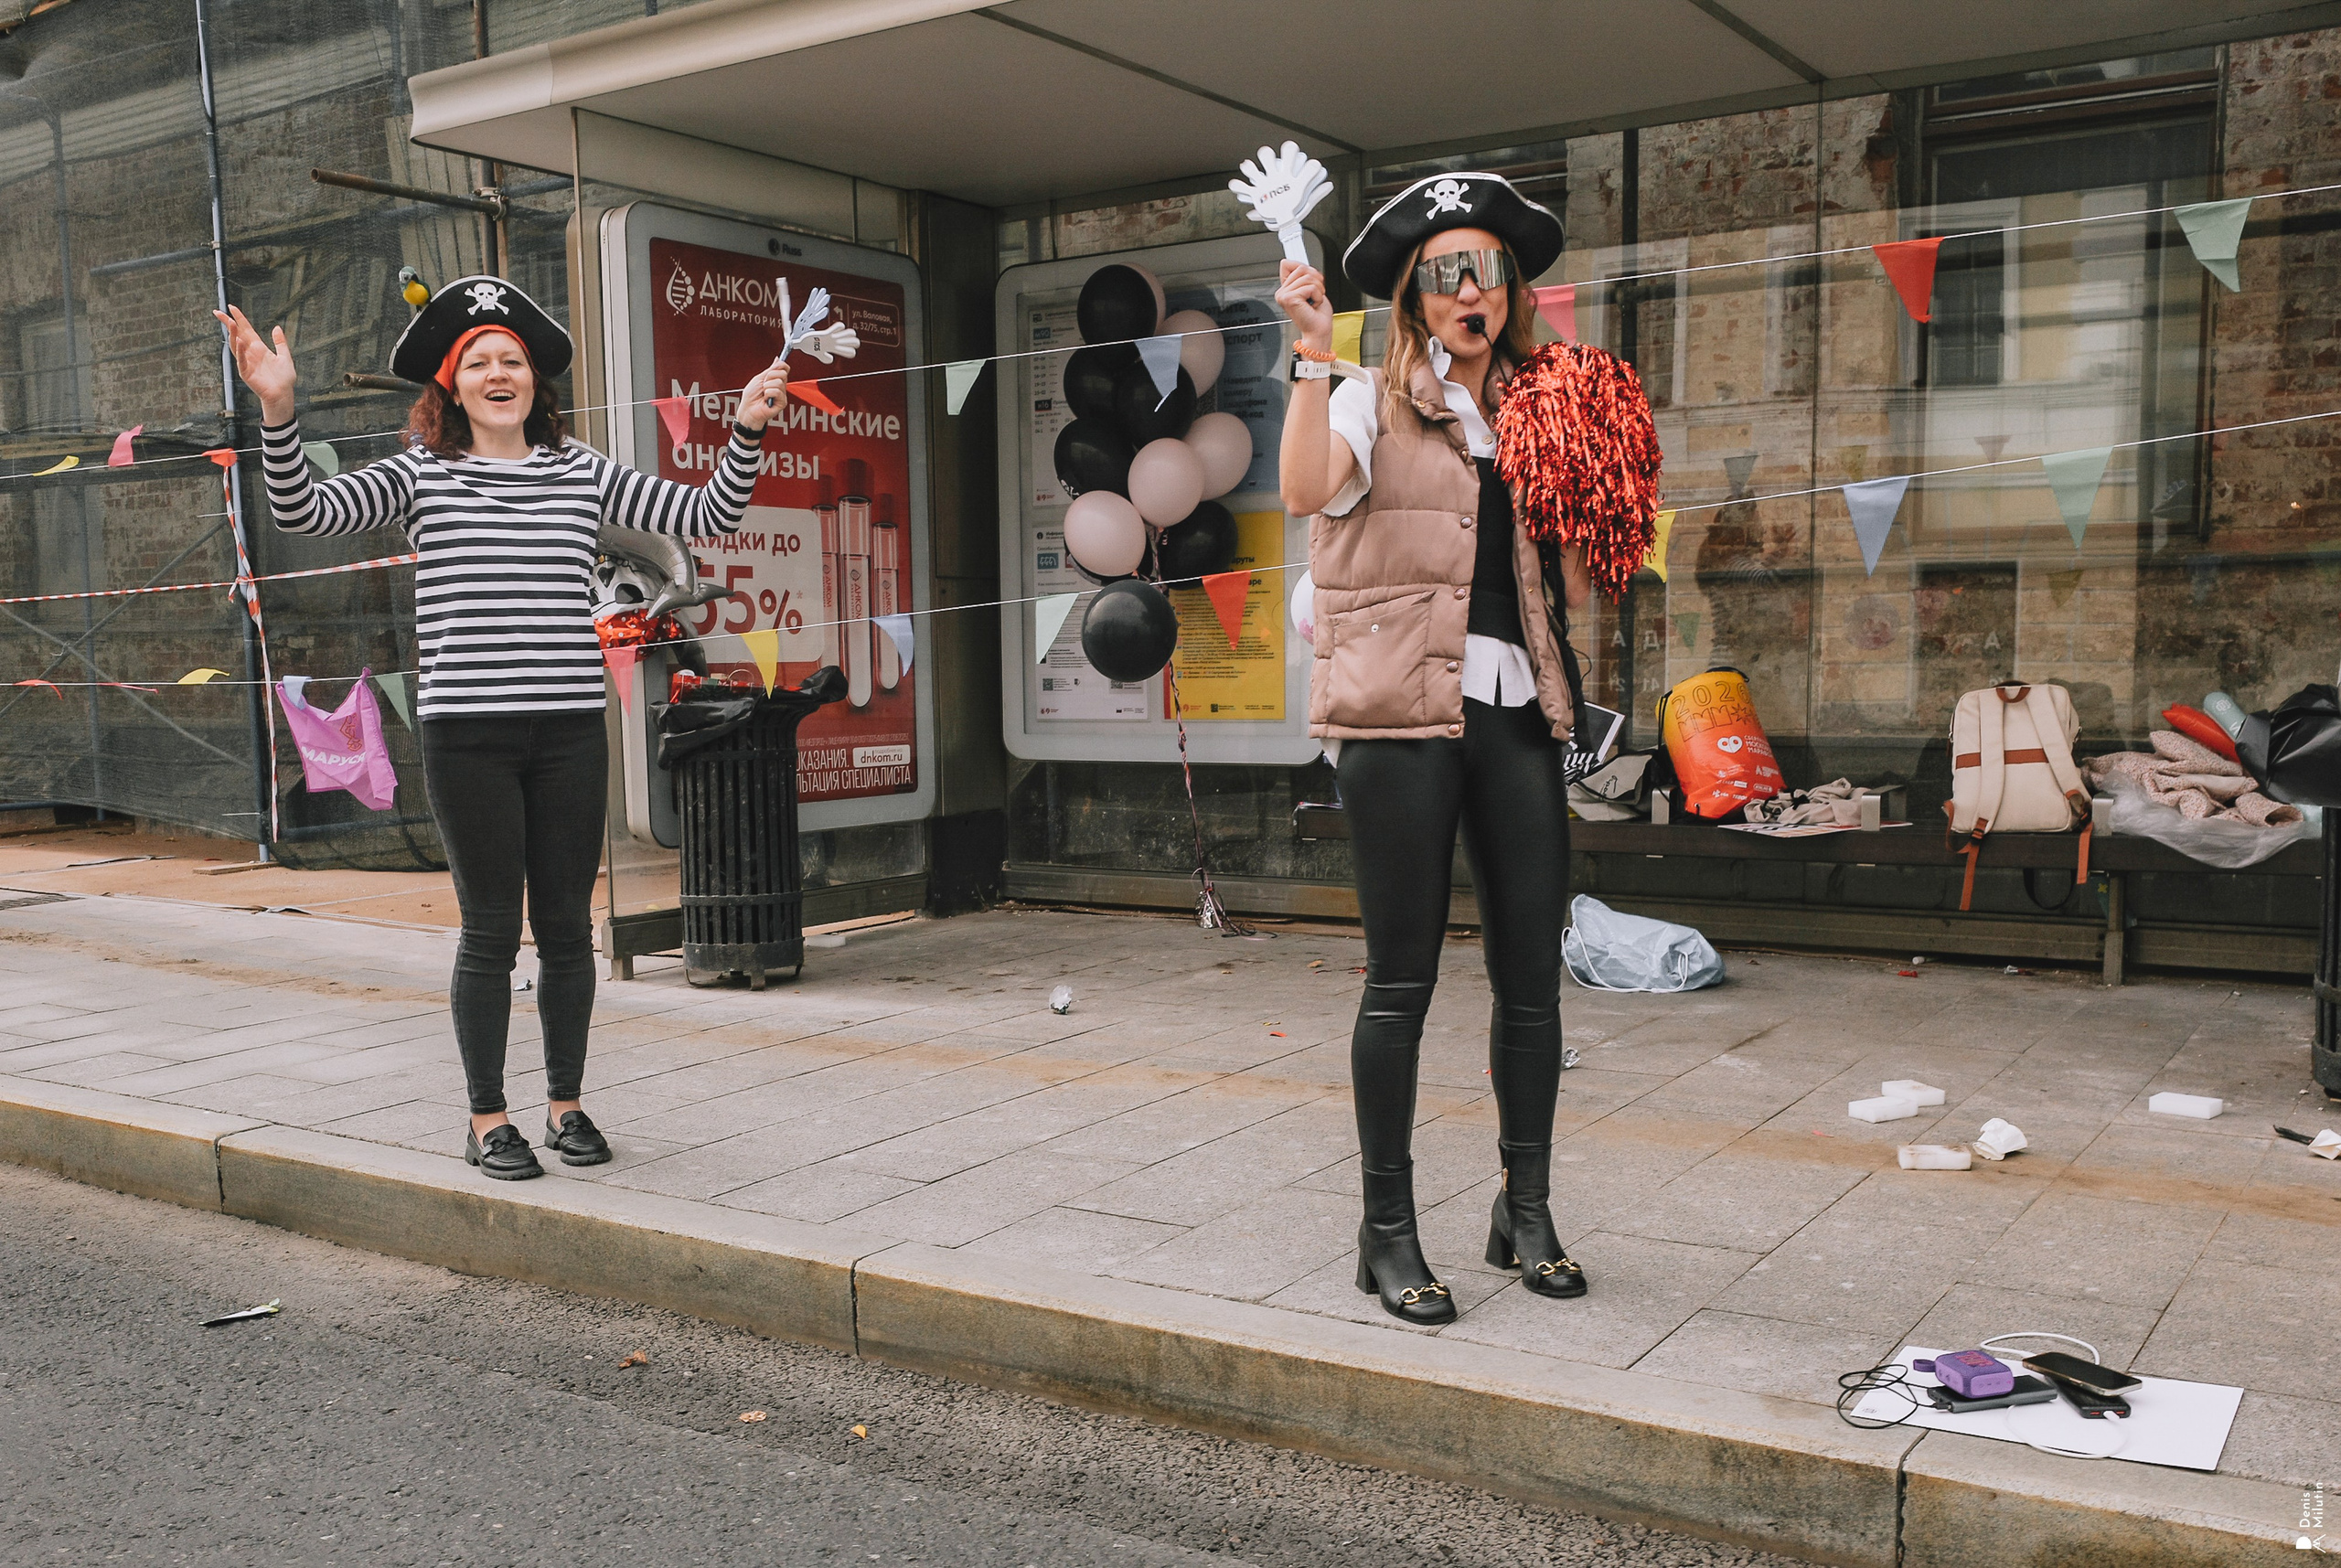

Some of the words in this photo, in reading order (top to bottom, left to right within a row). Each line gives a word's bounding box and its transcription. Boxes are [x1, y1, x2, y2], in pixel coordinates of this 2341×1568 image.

[700, 305, 784, 329] ЛАБОРАТОРИЯ
[671, 379, 900, 440] Медцинские
[687, 532, 765, 555] кидки
[772, 534, 801, 557] до
[884, 592, 893, 617] ДНКО
[301, 746, 367, 766] МАРУСЯ
[861, 751, 903, 764] dnkom.ru
[841, 765, 914, 789] СПЕЦИАЛИСТА.
